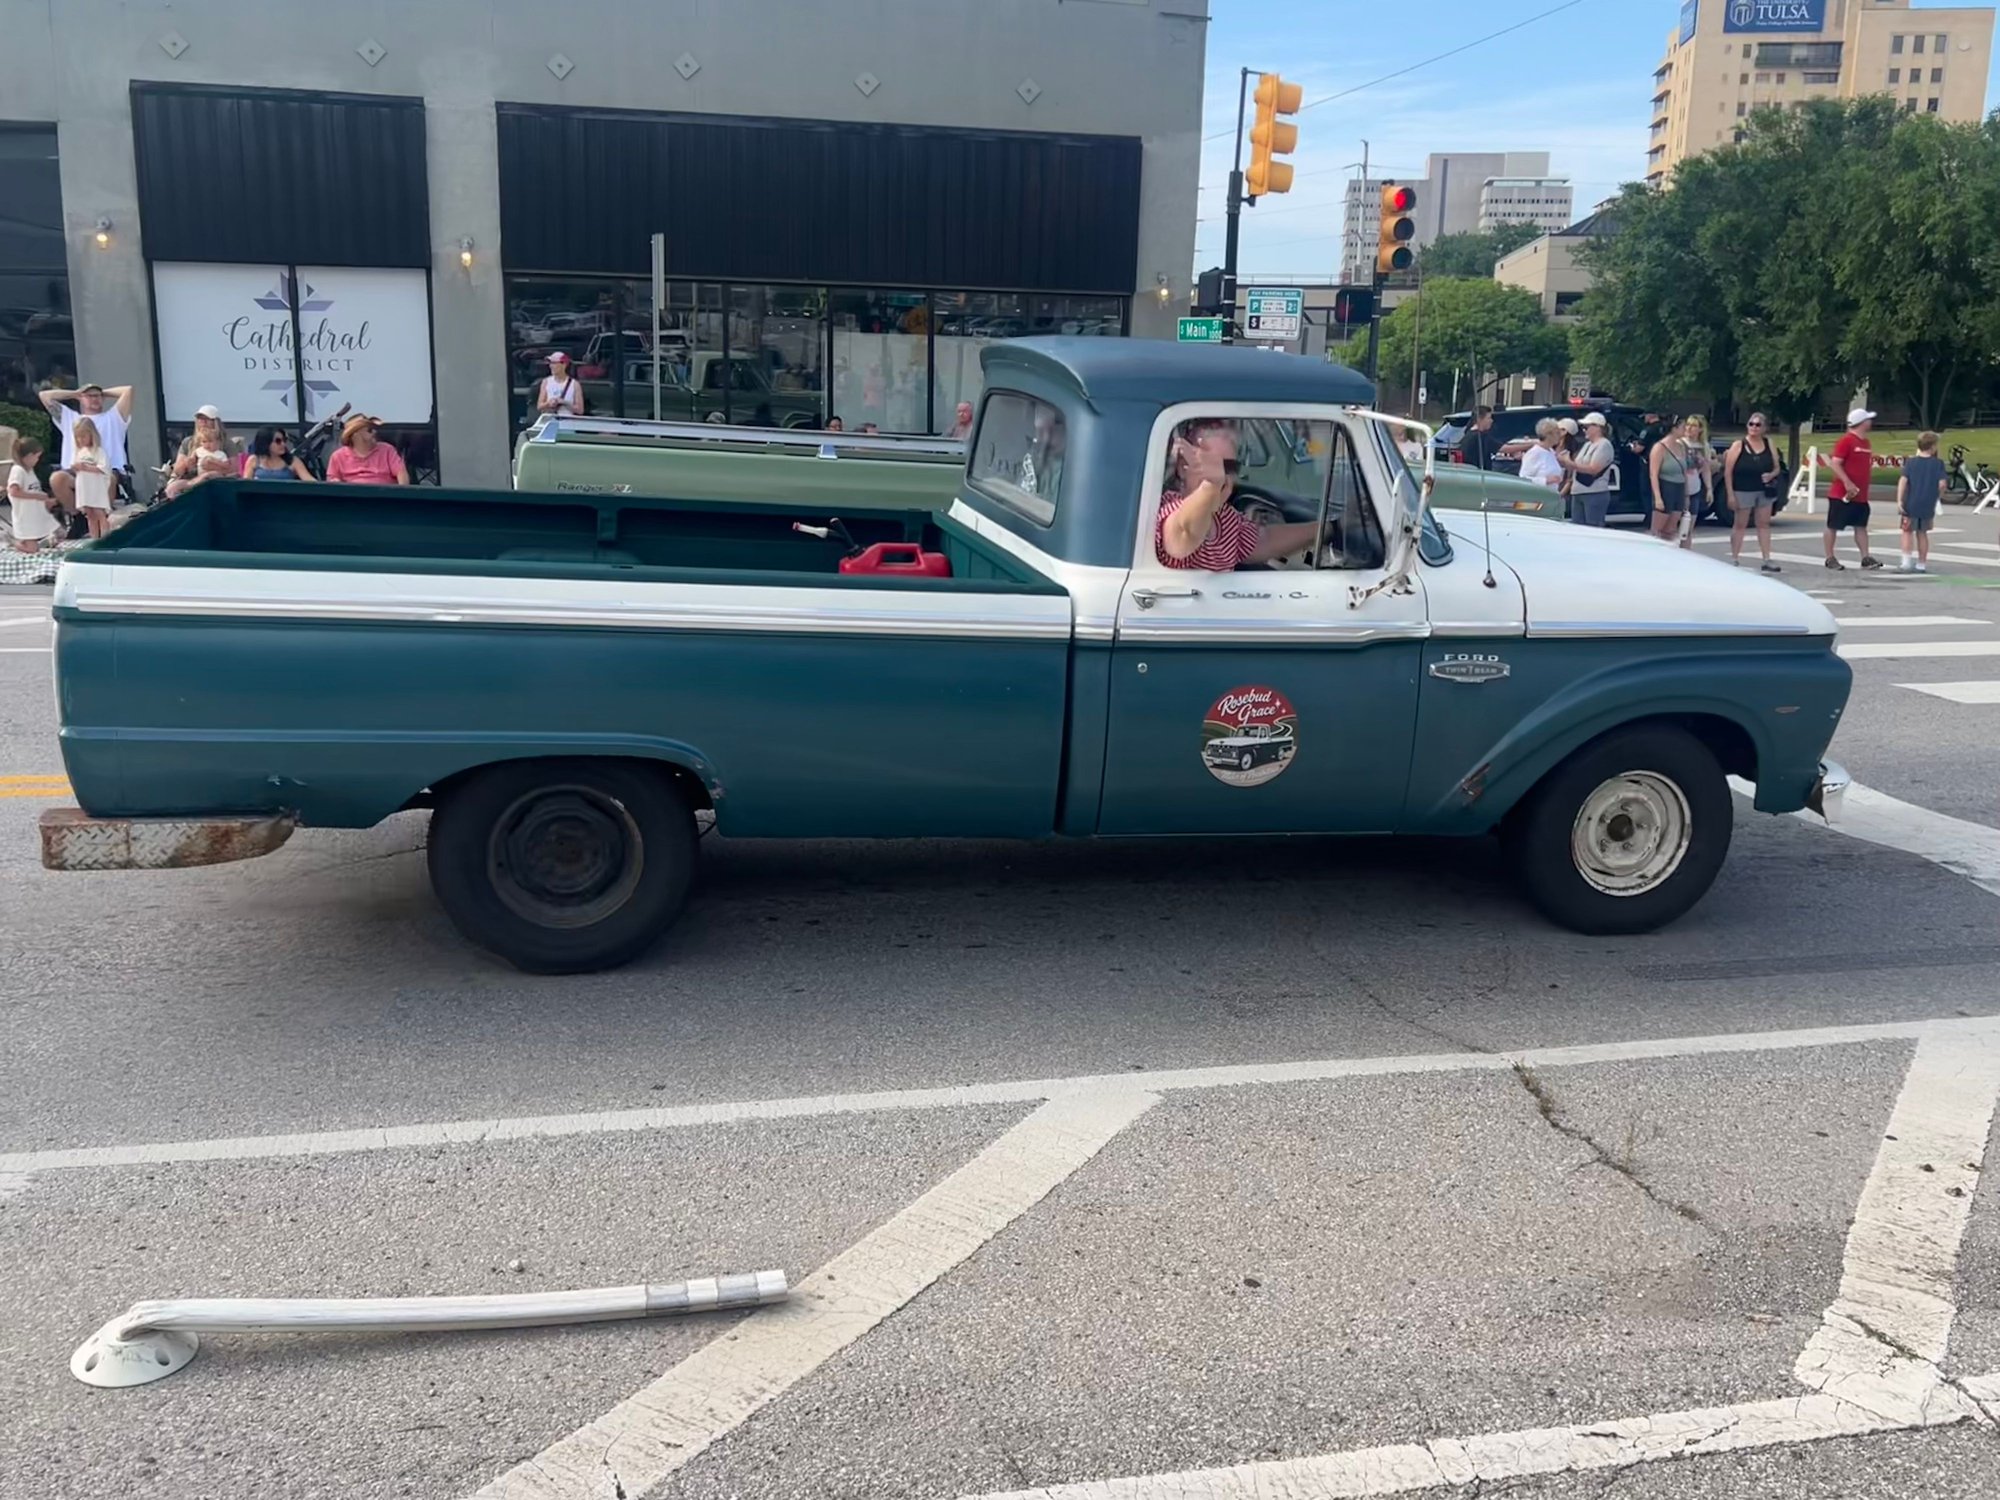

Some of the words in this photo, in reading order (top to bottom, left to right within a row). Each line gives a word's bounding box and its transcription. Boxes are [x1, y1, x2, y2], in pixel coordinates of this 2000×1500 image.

[1756, 5, 1810, 19] TULSA
[1252, 302, 1258, 311] P
[1287, 302, 1293, 311] 2
[222, 316, 371, 354] Cathedral
[1186, 321, 1207, 338] Main
[1212, 320, 1220, 329] ST
[244, 357, 354, 371] DISTRICT
[1571, 388, 1587, 398] 30
[1444, 653, 1499, 662] FORD
[1217, 688, 1272, 717] Rosebud
[1238, 703, 1277, 726] Grace
